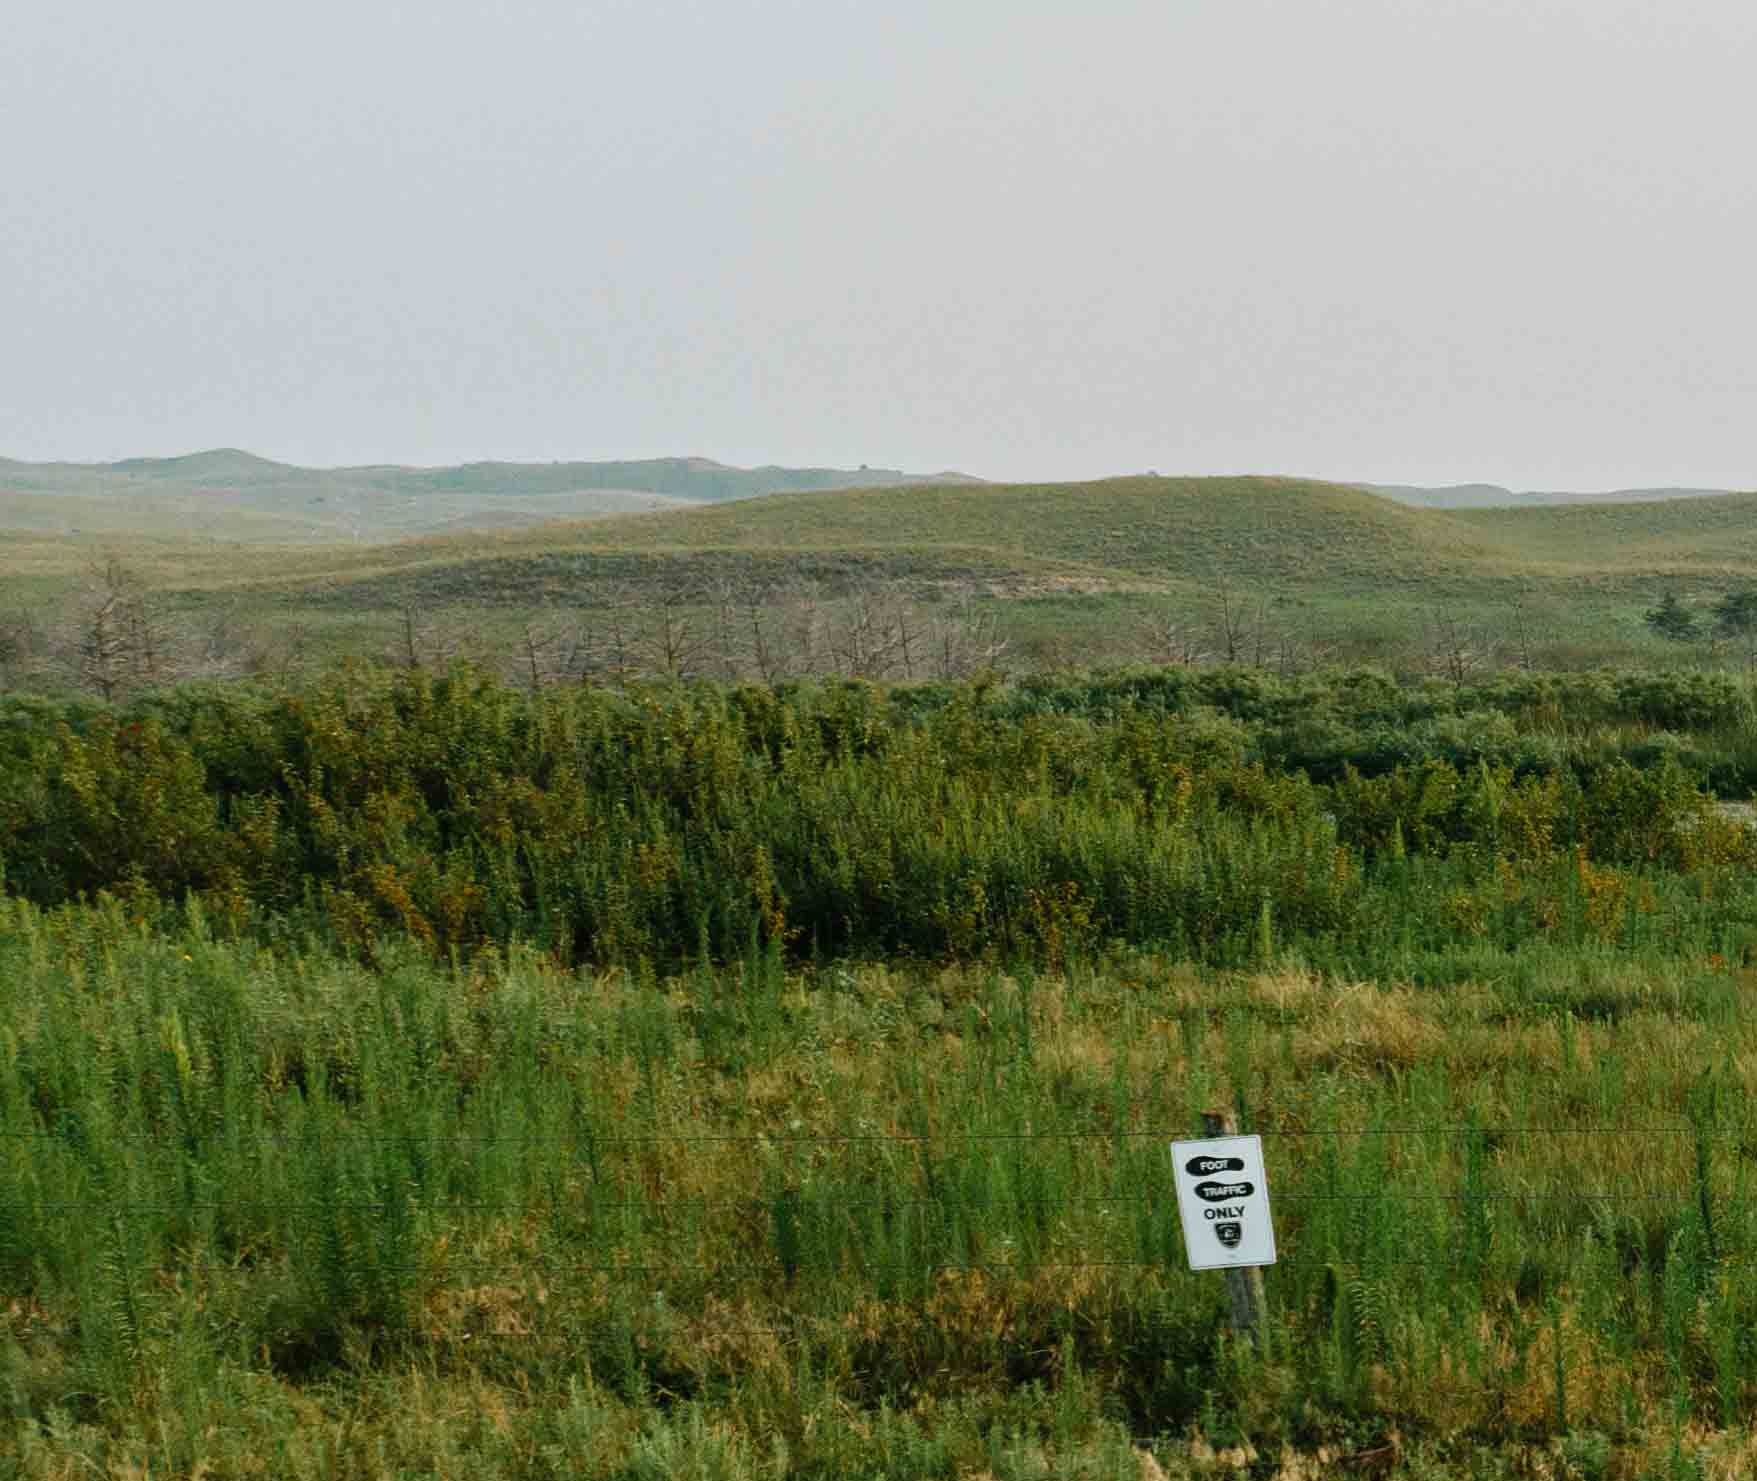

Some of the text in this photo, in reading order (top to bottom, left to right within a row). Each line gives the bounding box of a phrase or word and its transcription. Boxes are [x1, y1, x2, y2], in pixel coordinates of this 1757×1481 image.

[1199, 1160, 1228, 1170] FOOT
[1203, 1185, 1247, 1197] TRAFFIC
[1204, 1206, 1245, 1220] ONLY
